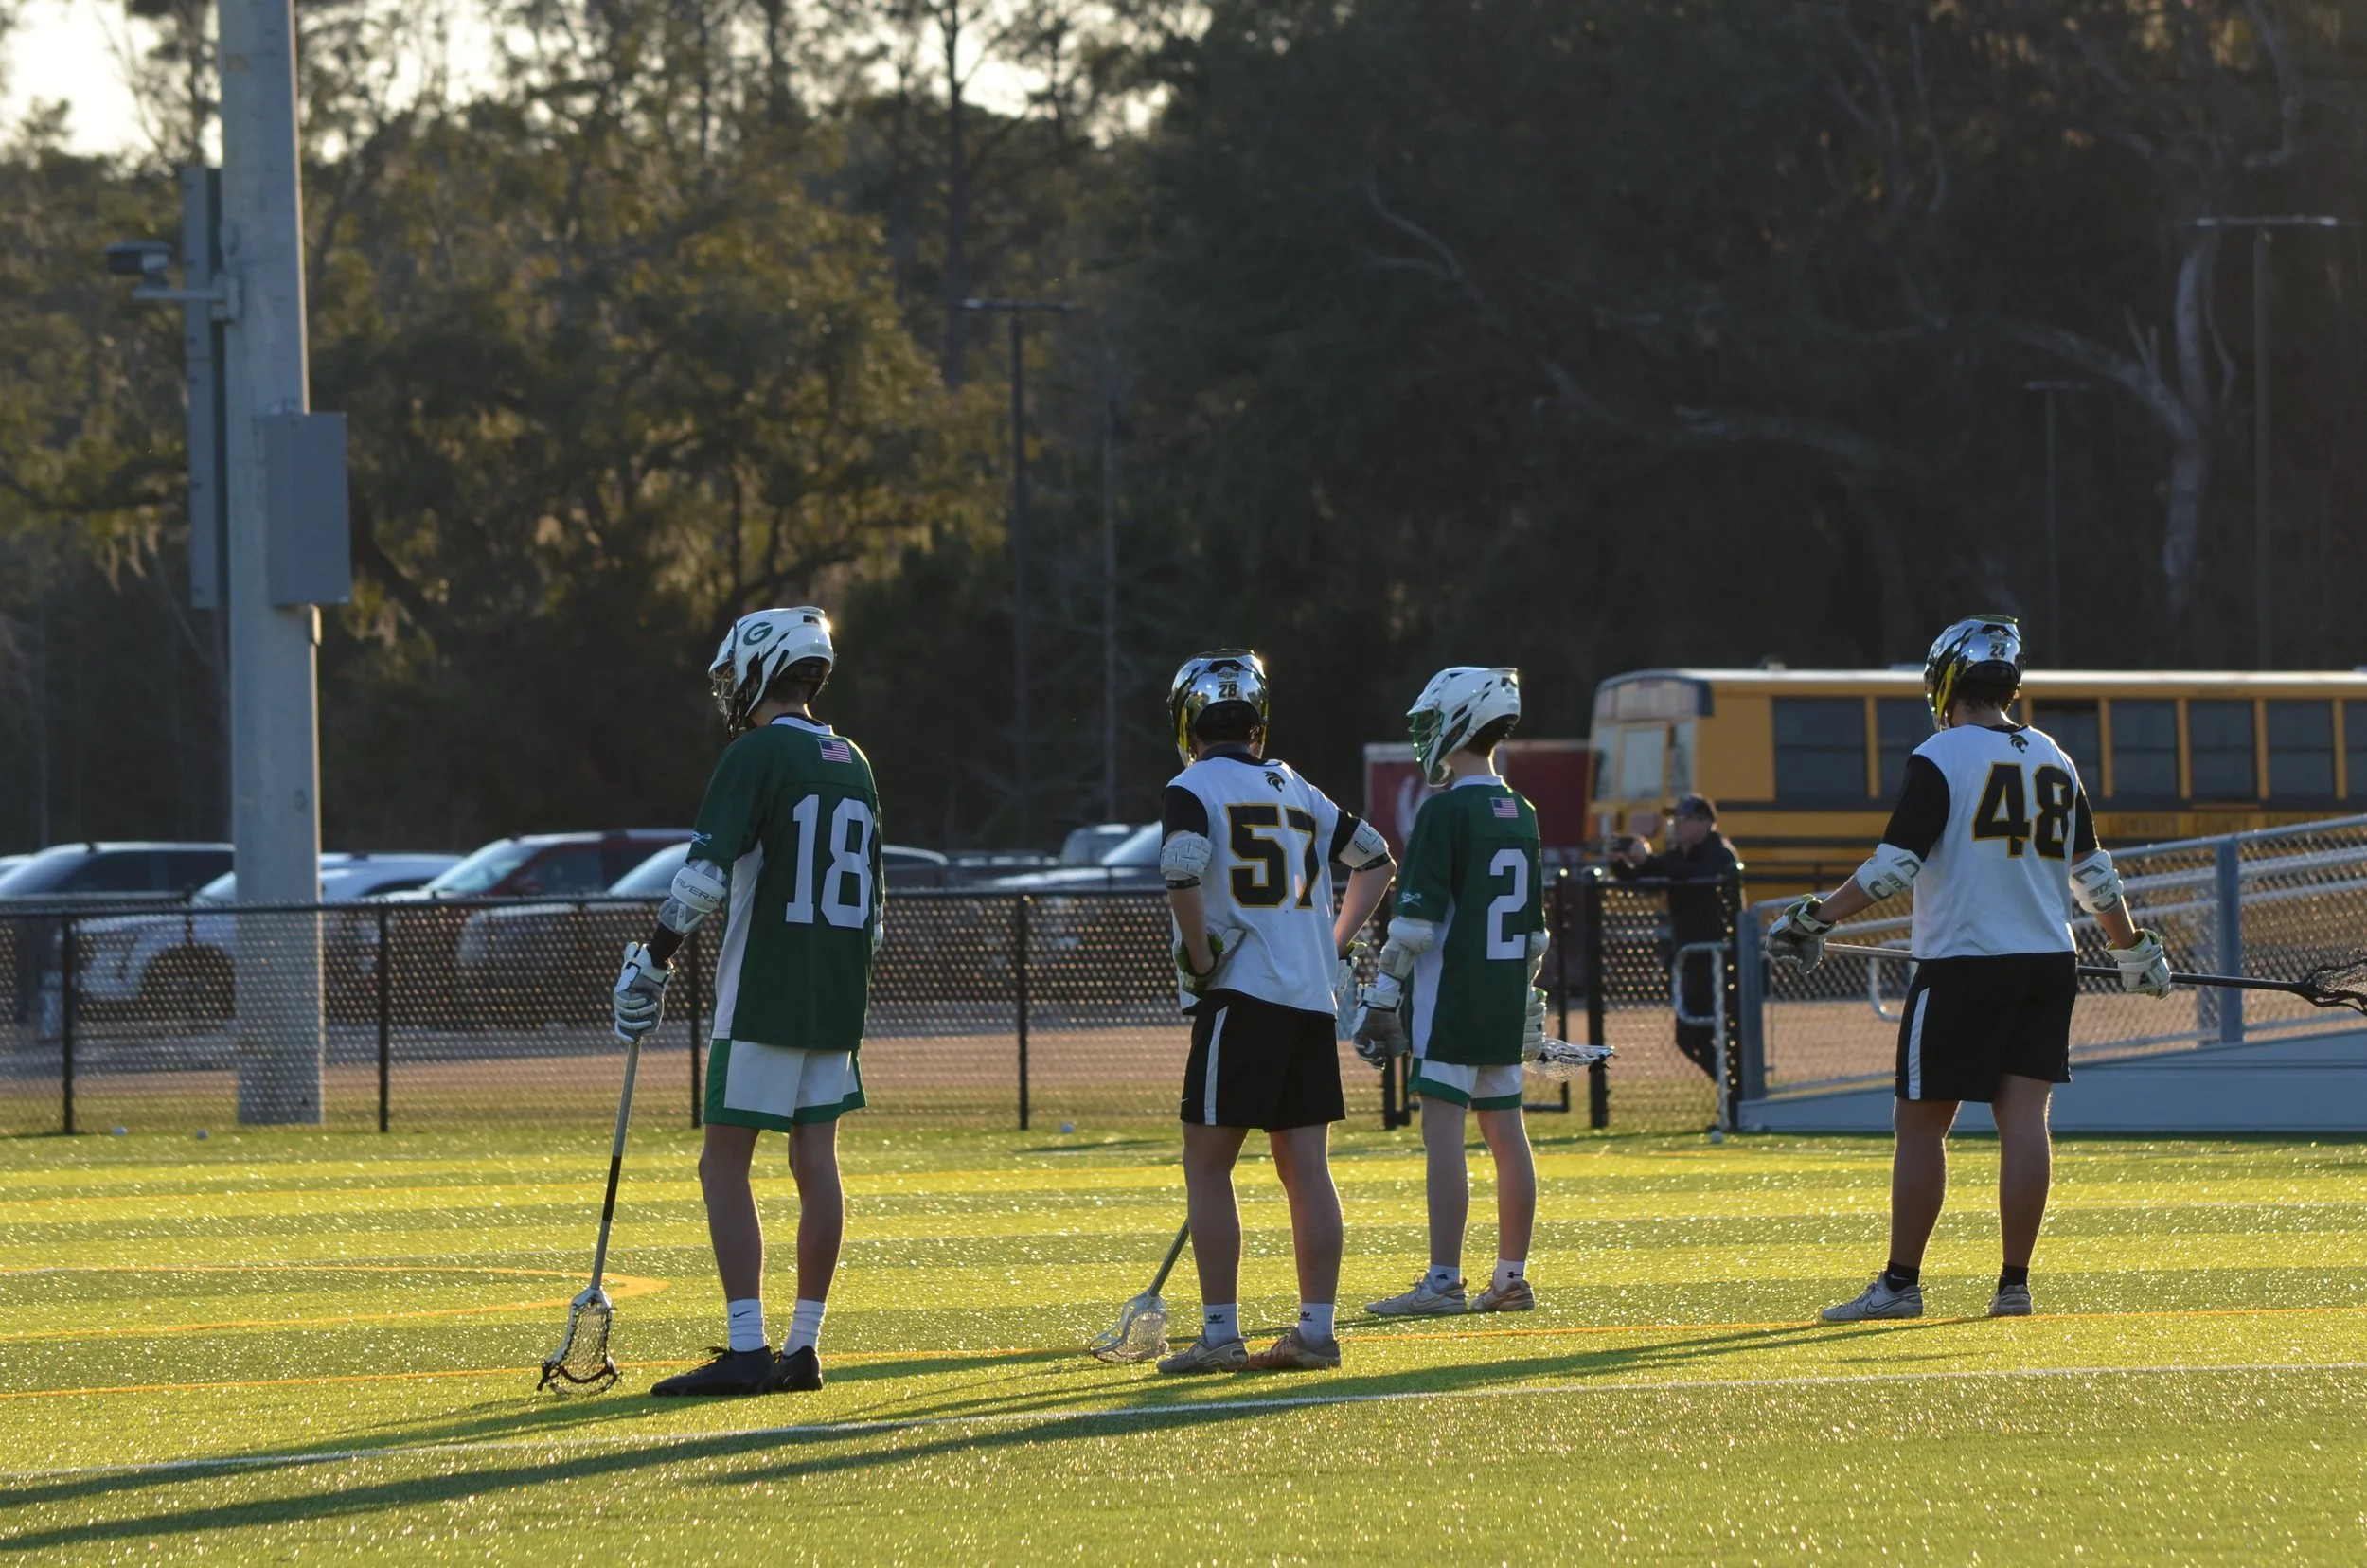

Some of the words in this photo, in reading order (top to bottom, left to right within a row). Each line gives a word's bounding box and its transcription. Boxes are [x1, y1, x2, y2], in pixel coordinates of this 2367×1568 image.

[743, 621, 774, 646] G
[1218, 683, 1237, 698] 28
[785, 793, 875, 930] 18
[1225, 803, 1320, 910] 57
[1971, 761, 2076, 862] 48
[1486, 847, 1529, 961] 2
